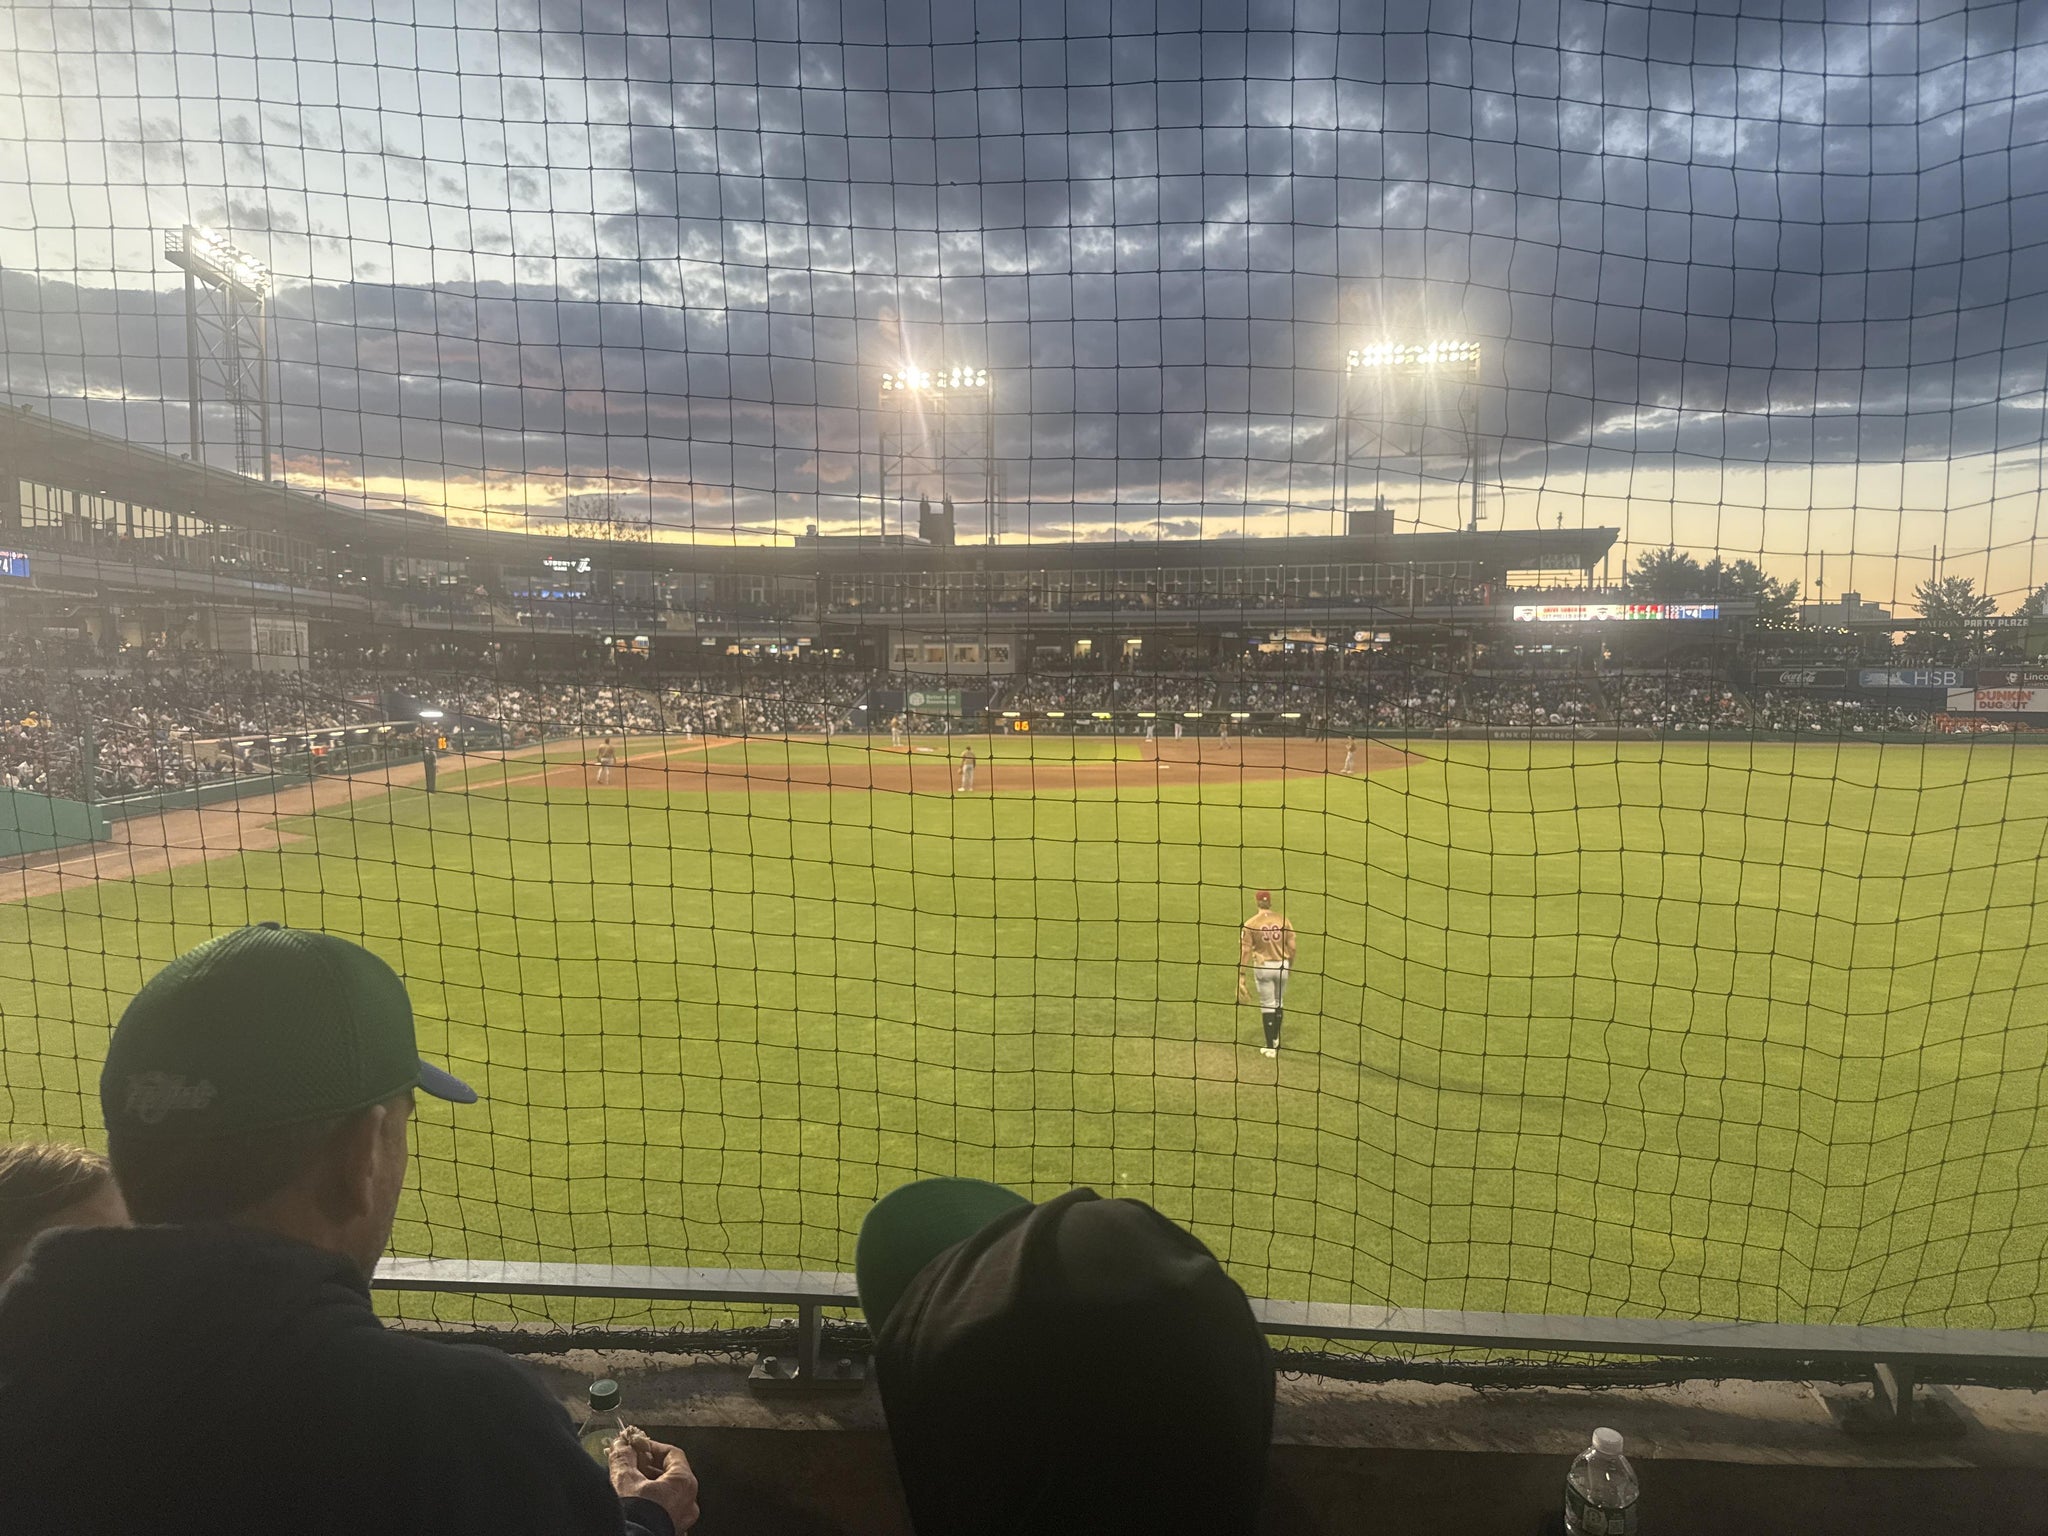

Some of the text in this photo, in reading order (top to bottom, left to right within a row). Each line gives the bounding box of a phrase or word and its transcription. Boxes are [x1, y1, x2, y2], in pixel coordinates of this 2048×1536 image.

[1964, 619, 1995, 627] PARTY
[1998, 618, 2029, 627] PLAZA
[1914, 671, 1957, 686] HSB
[1976, 690, 2035, 702] DUNKIN'
[1979, 701, 2028, 710] DUGOUT
[1494, 731, 1519, 739] BANK
